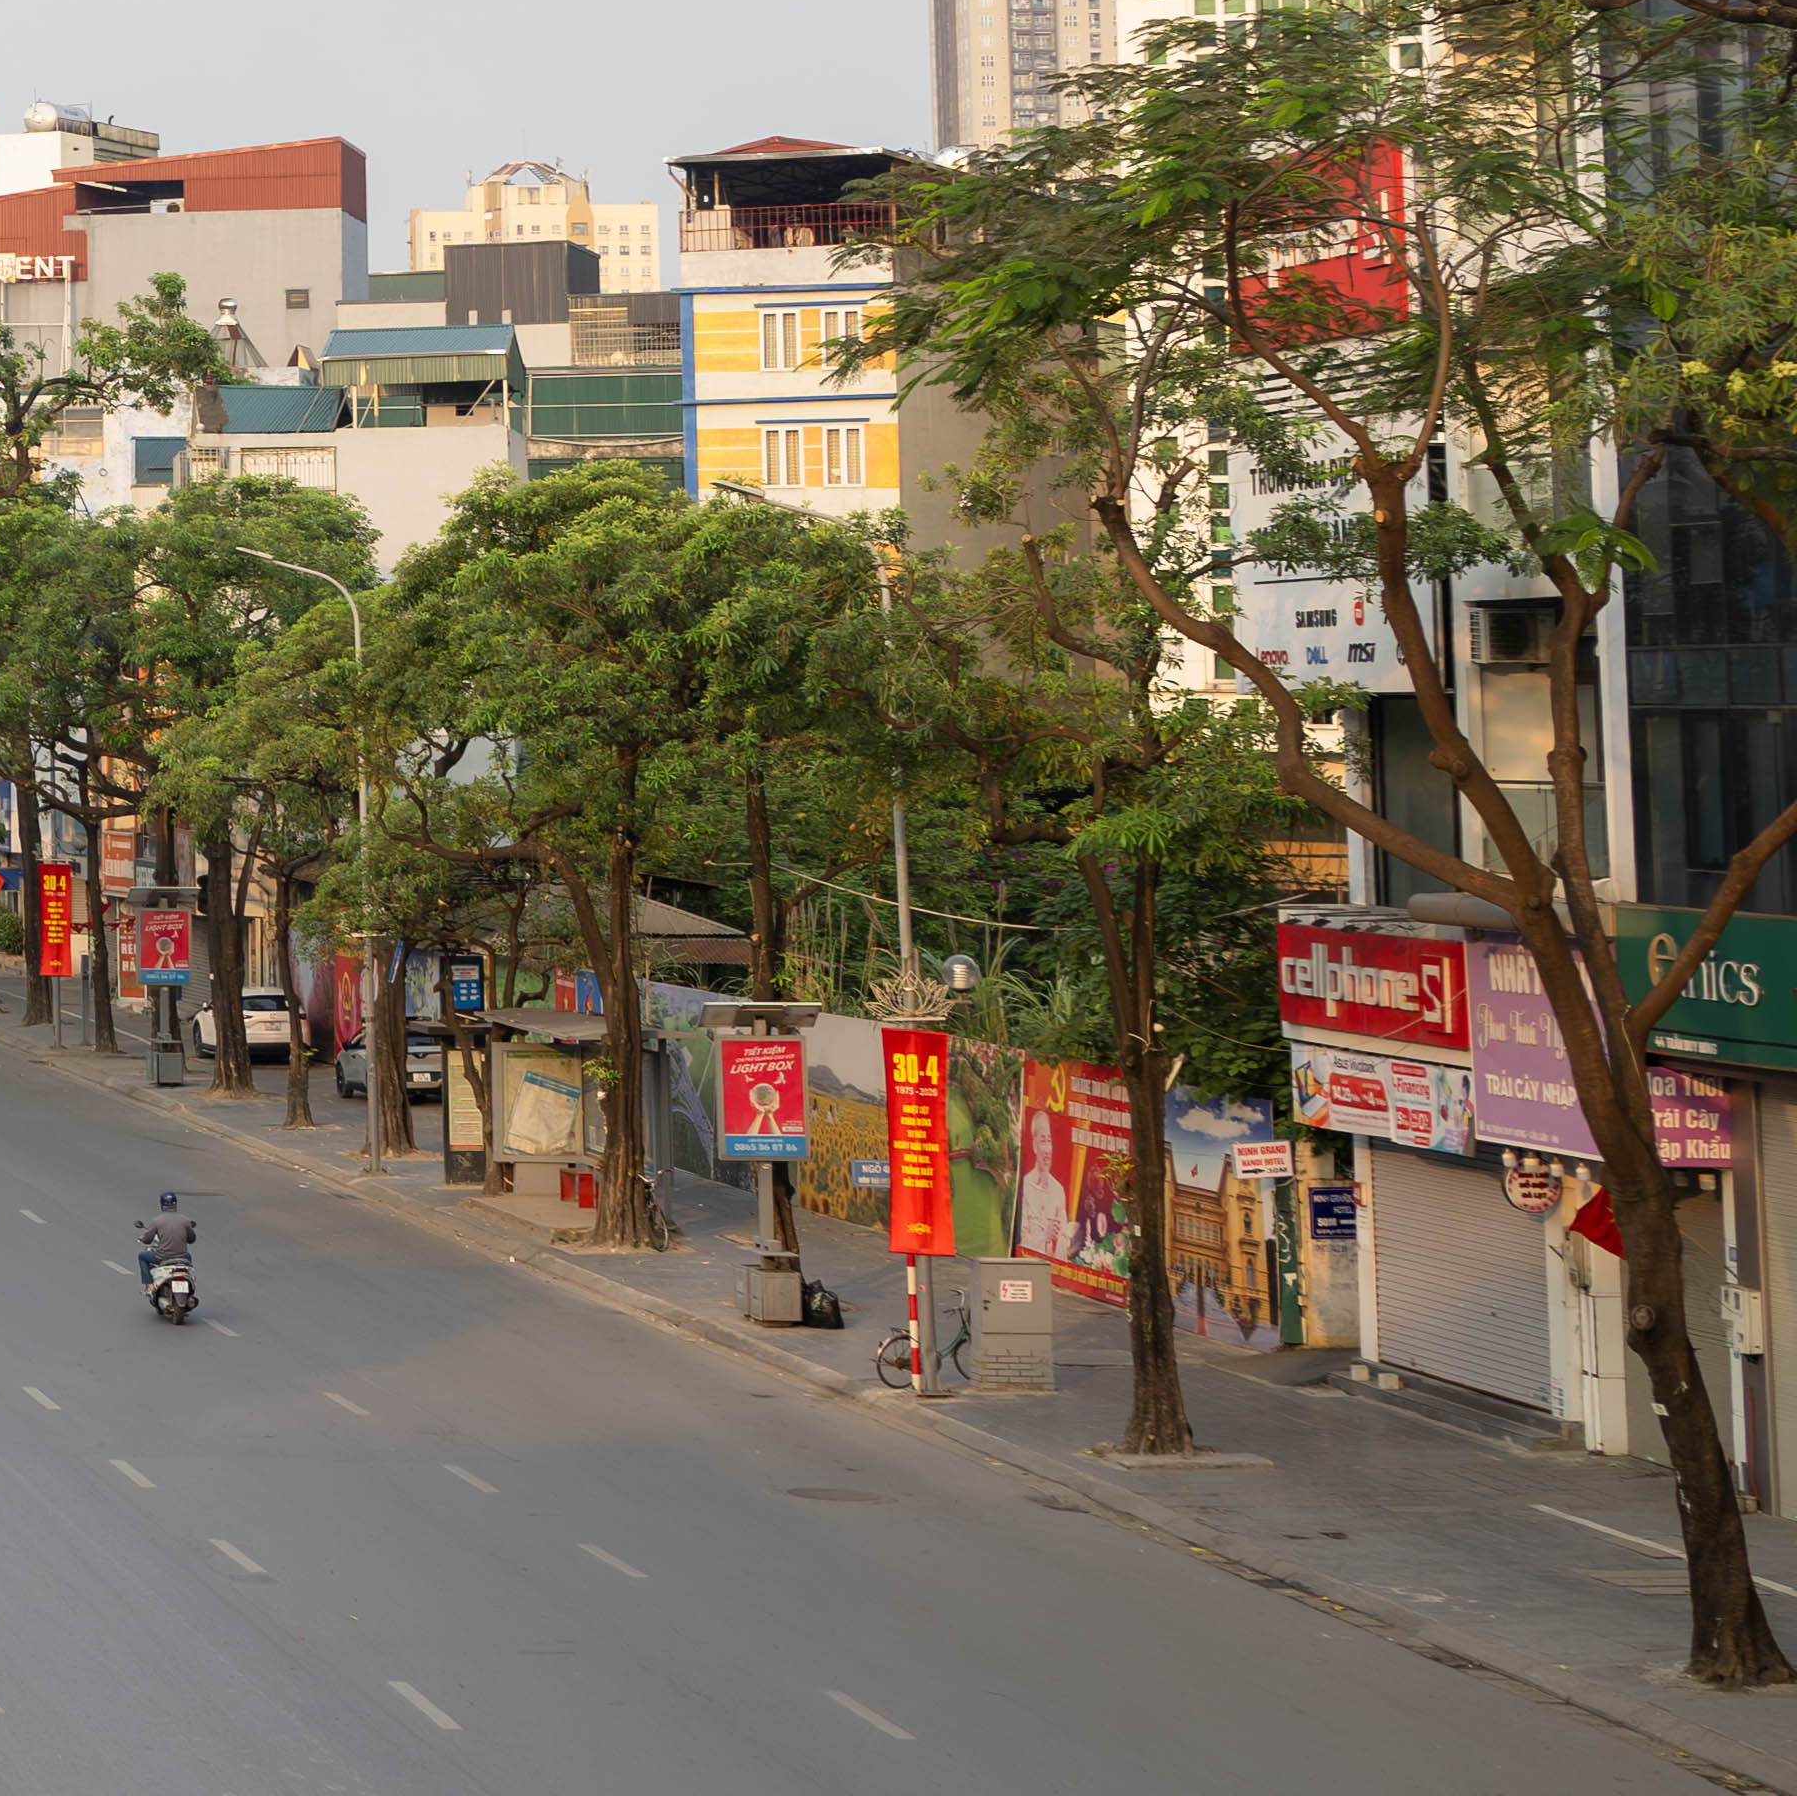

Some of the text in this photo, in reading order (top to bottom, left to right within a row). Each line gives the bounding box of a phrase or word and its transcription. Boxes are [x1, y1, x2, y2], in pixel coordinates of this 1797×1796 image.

[1295, 608, 1338, 629] SAMSUNG
[1647, 932, 1762, 1006] ehics
[730, 1060, 795, 1075] LIGHT BOX
[893, 1053, 939, 1085] 30-4
[1649, 1107, 1721, 1132] rái Cây
[1686, 1133, 1733, 1160] Khẩu
